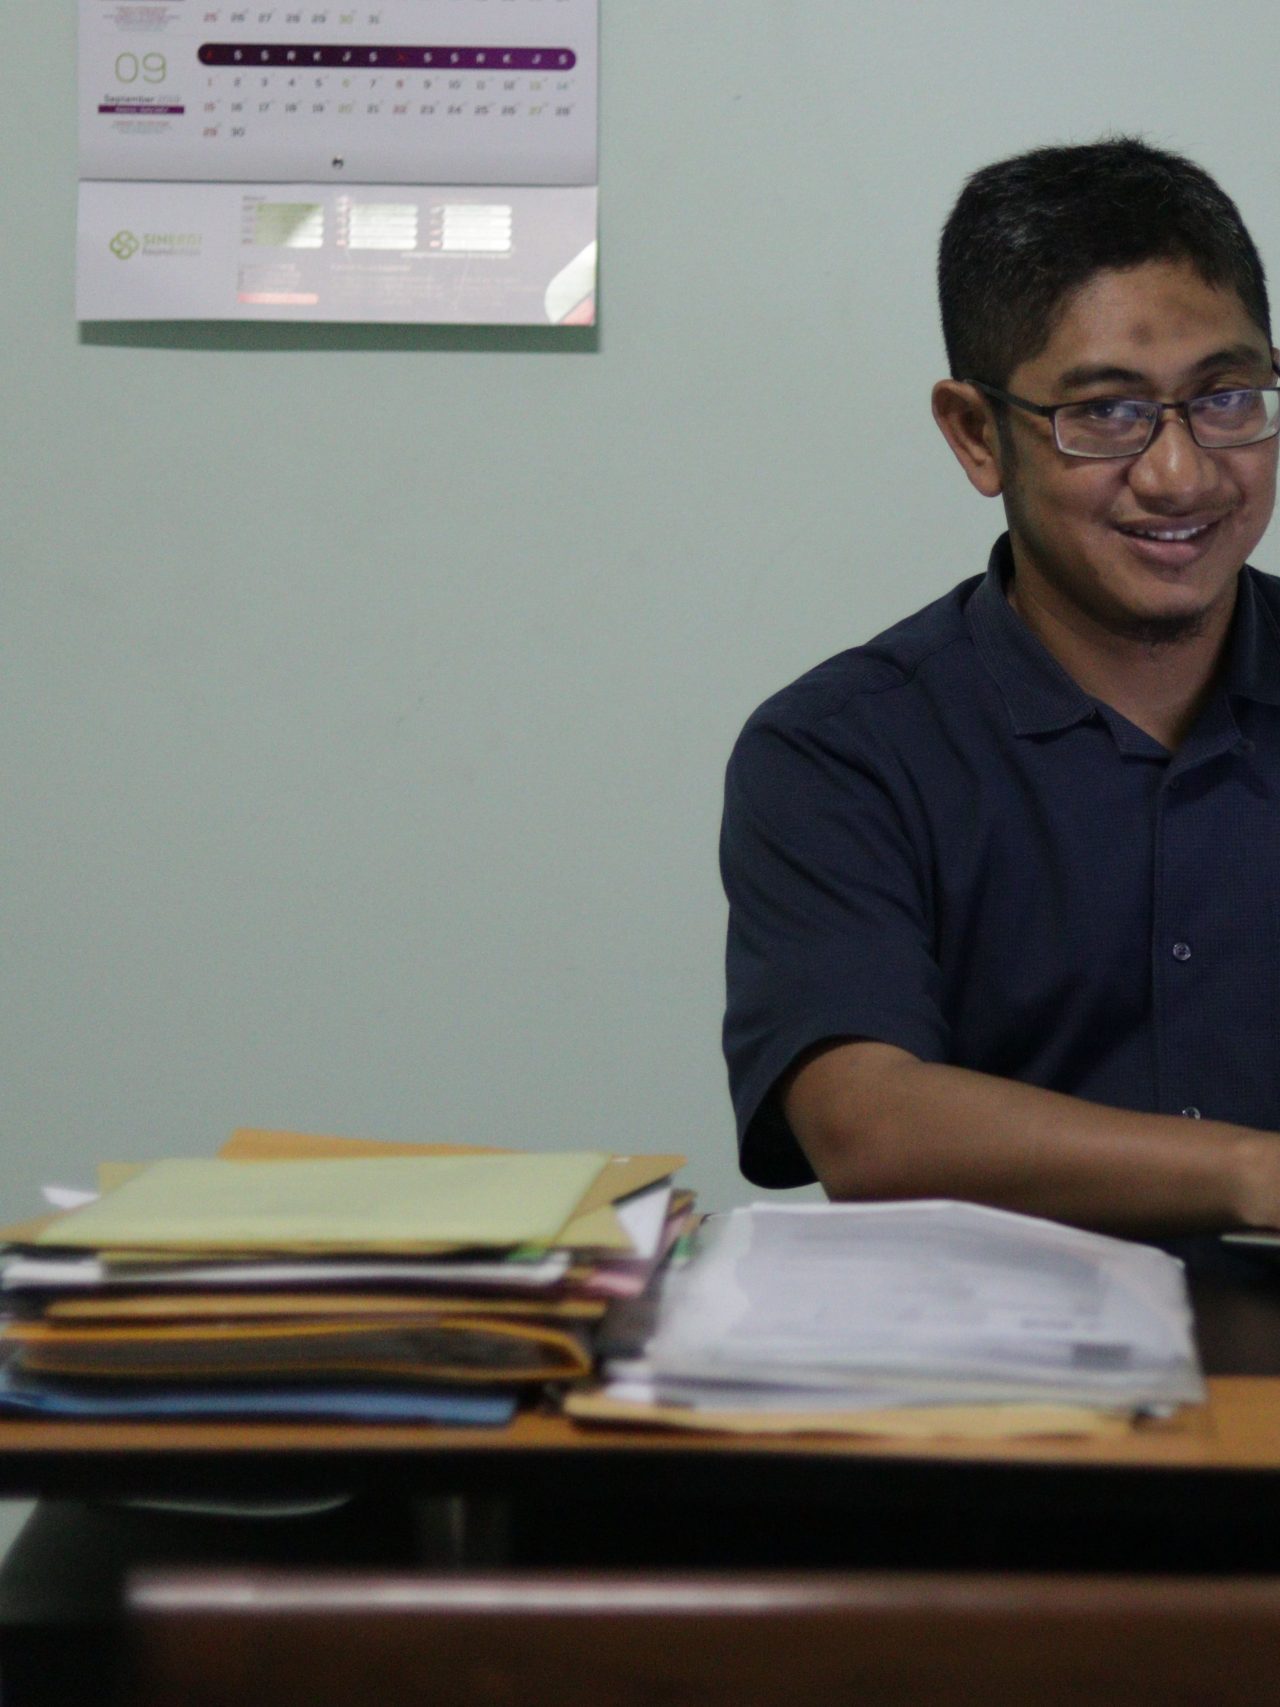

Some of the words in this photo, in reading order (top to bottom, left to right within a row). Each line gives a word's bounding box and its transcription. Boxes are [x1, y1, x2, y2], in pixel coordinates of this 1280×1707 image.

[258, 13, 272, 23] 27
[115, 51, 167, 84] 09
[104, 94, 155, 104] September
[259, 103, 270, 113] 17
[420, 104, 434, 114] 23
